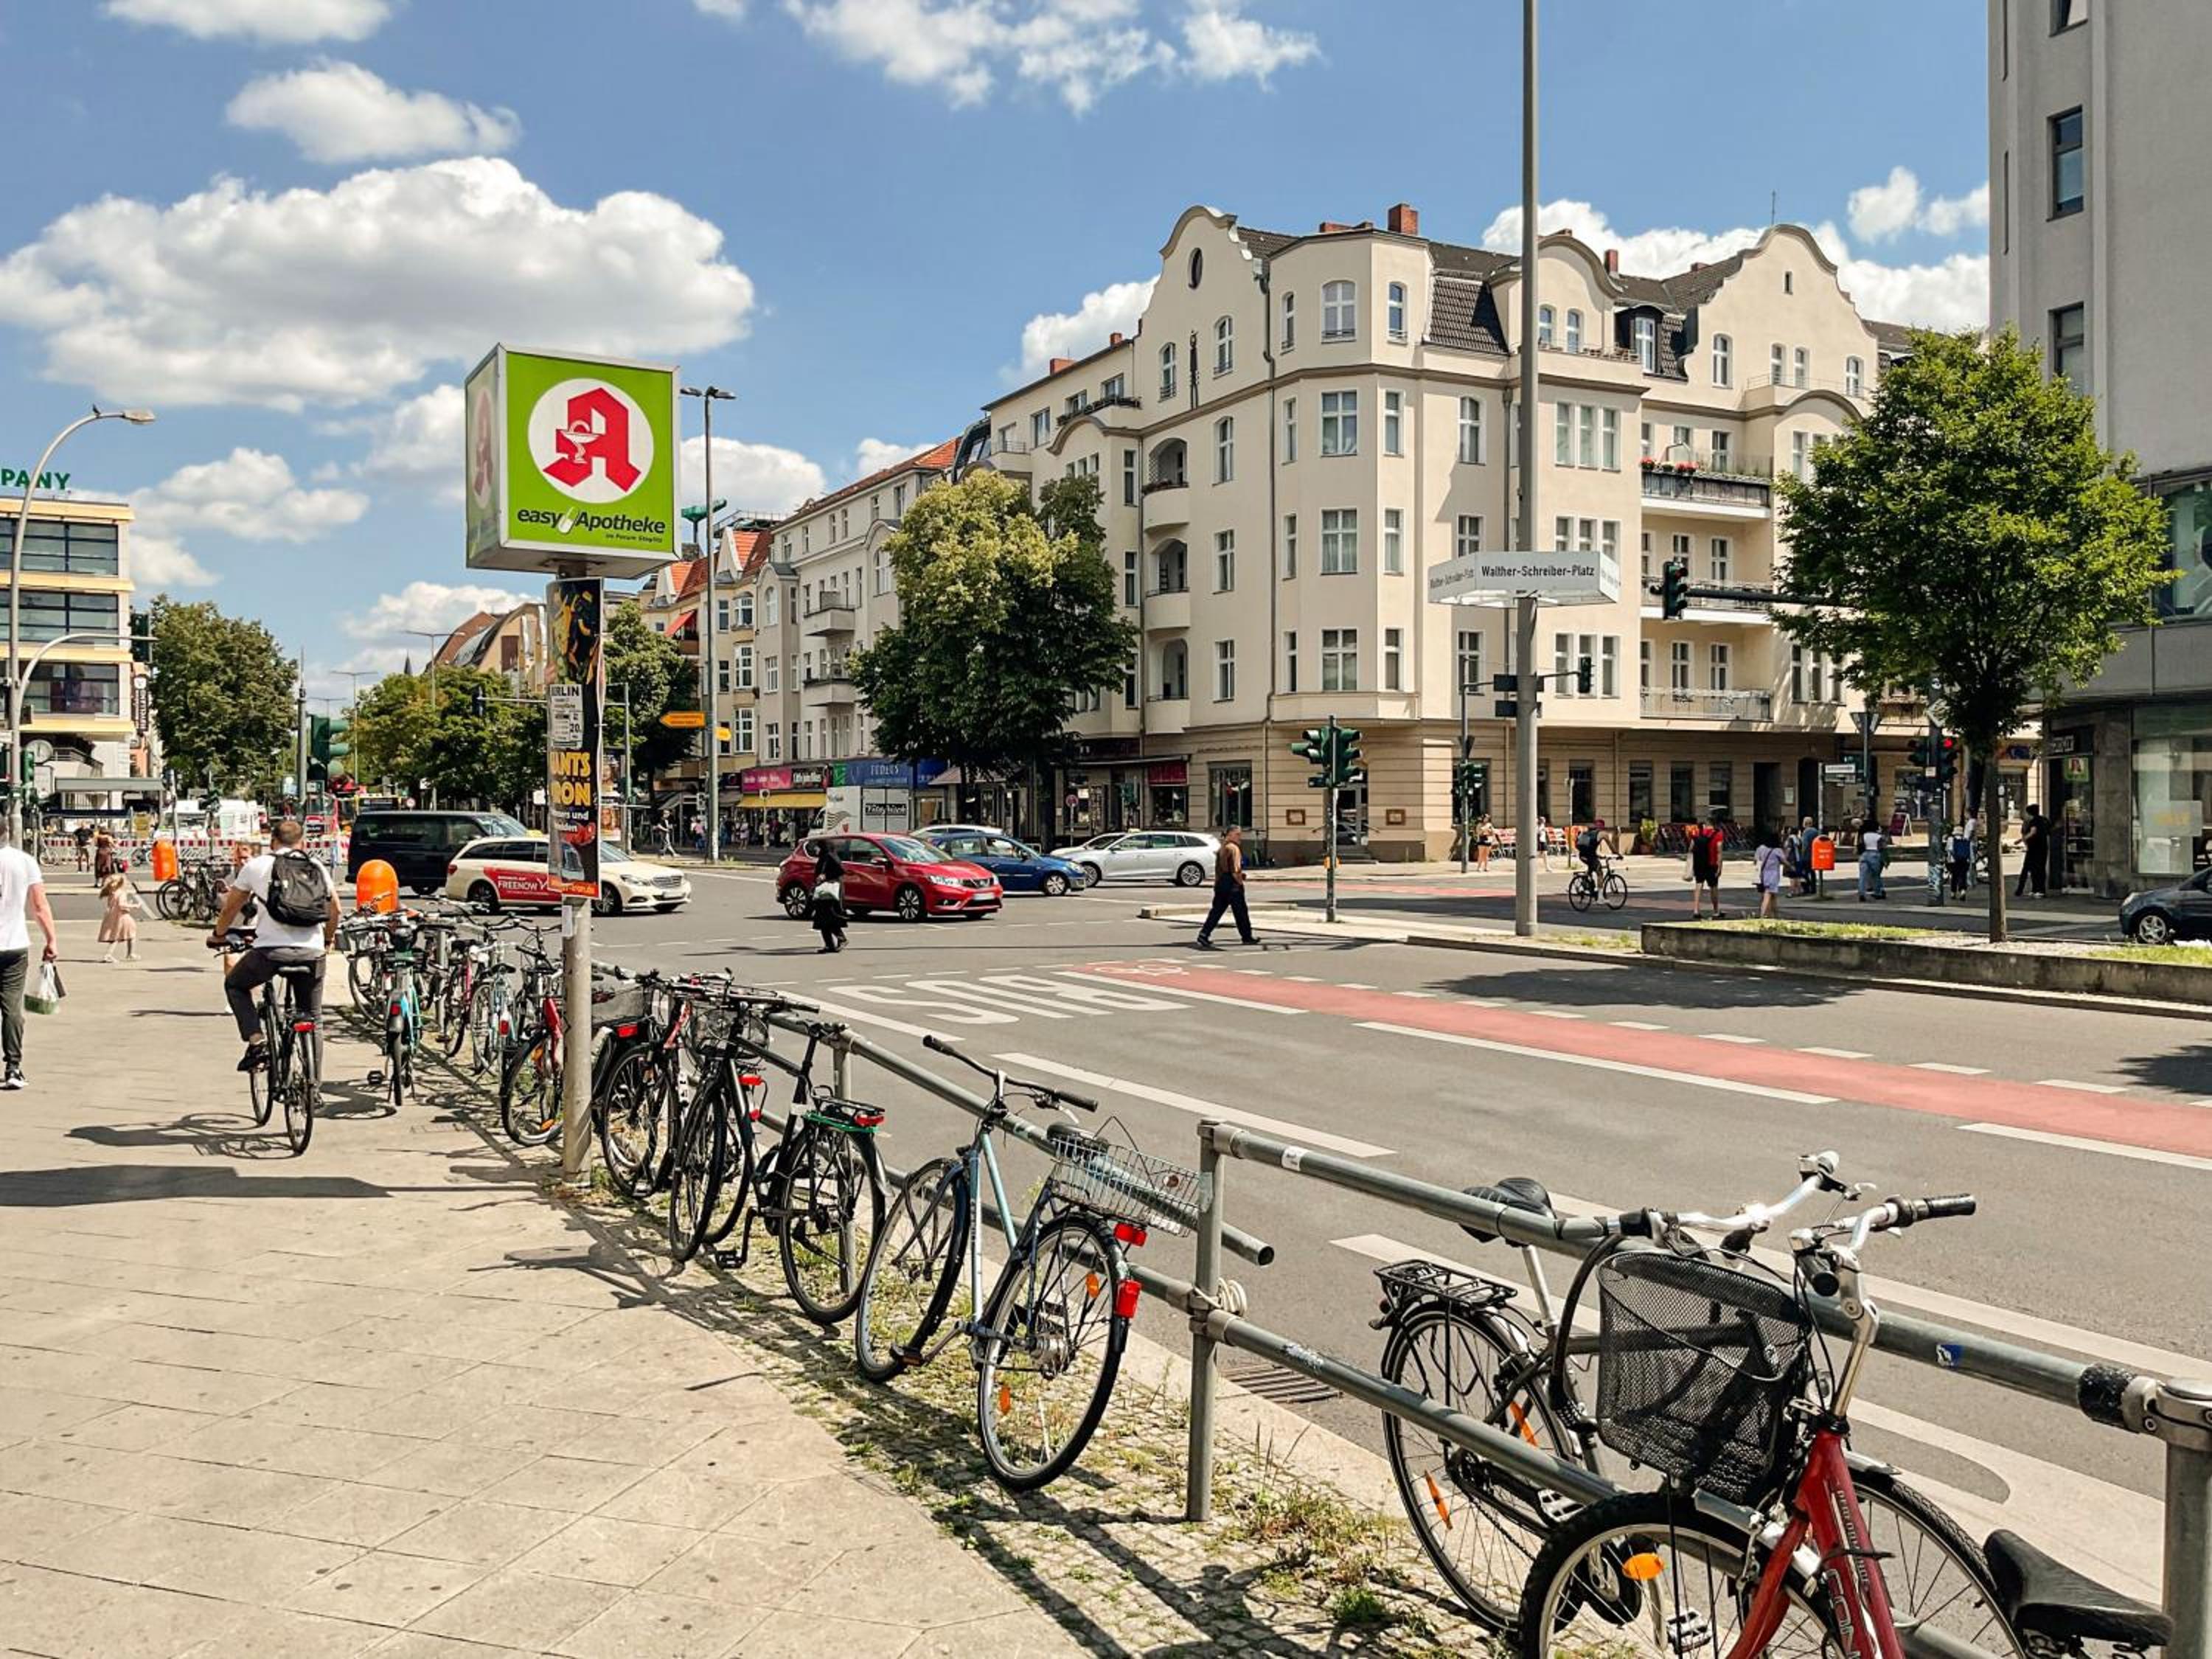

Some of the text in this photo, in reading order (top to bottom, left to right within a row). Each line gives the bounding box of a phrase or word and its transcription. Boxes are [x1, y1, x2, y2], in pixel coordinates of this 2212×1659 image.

[518, 509, 666, 534] easy Apotheke
[1481, 564, 1595, 577] Walther-Schreiber-Platz
[498, 880, 538, 891] FREENOW
[827, 974, 1195, 1025] BUS
